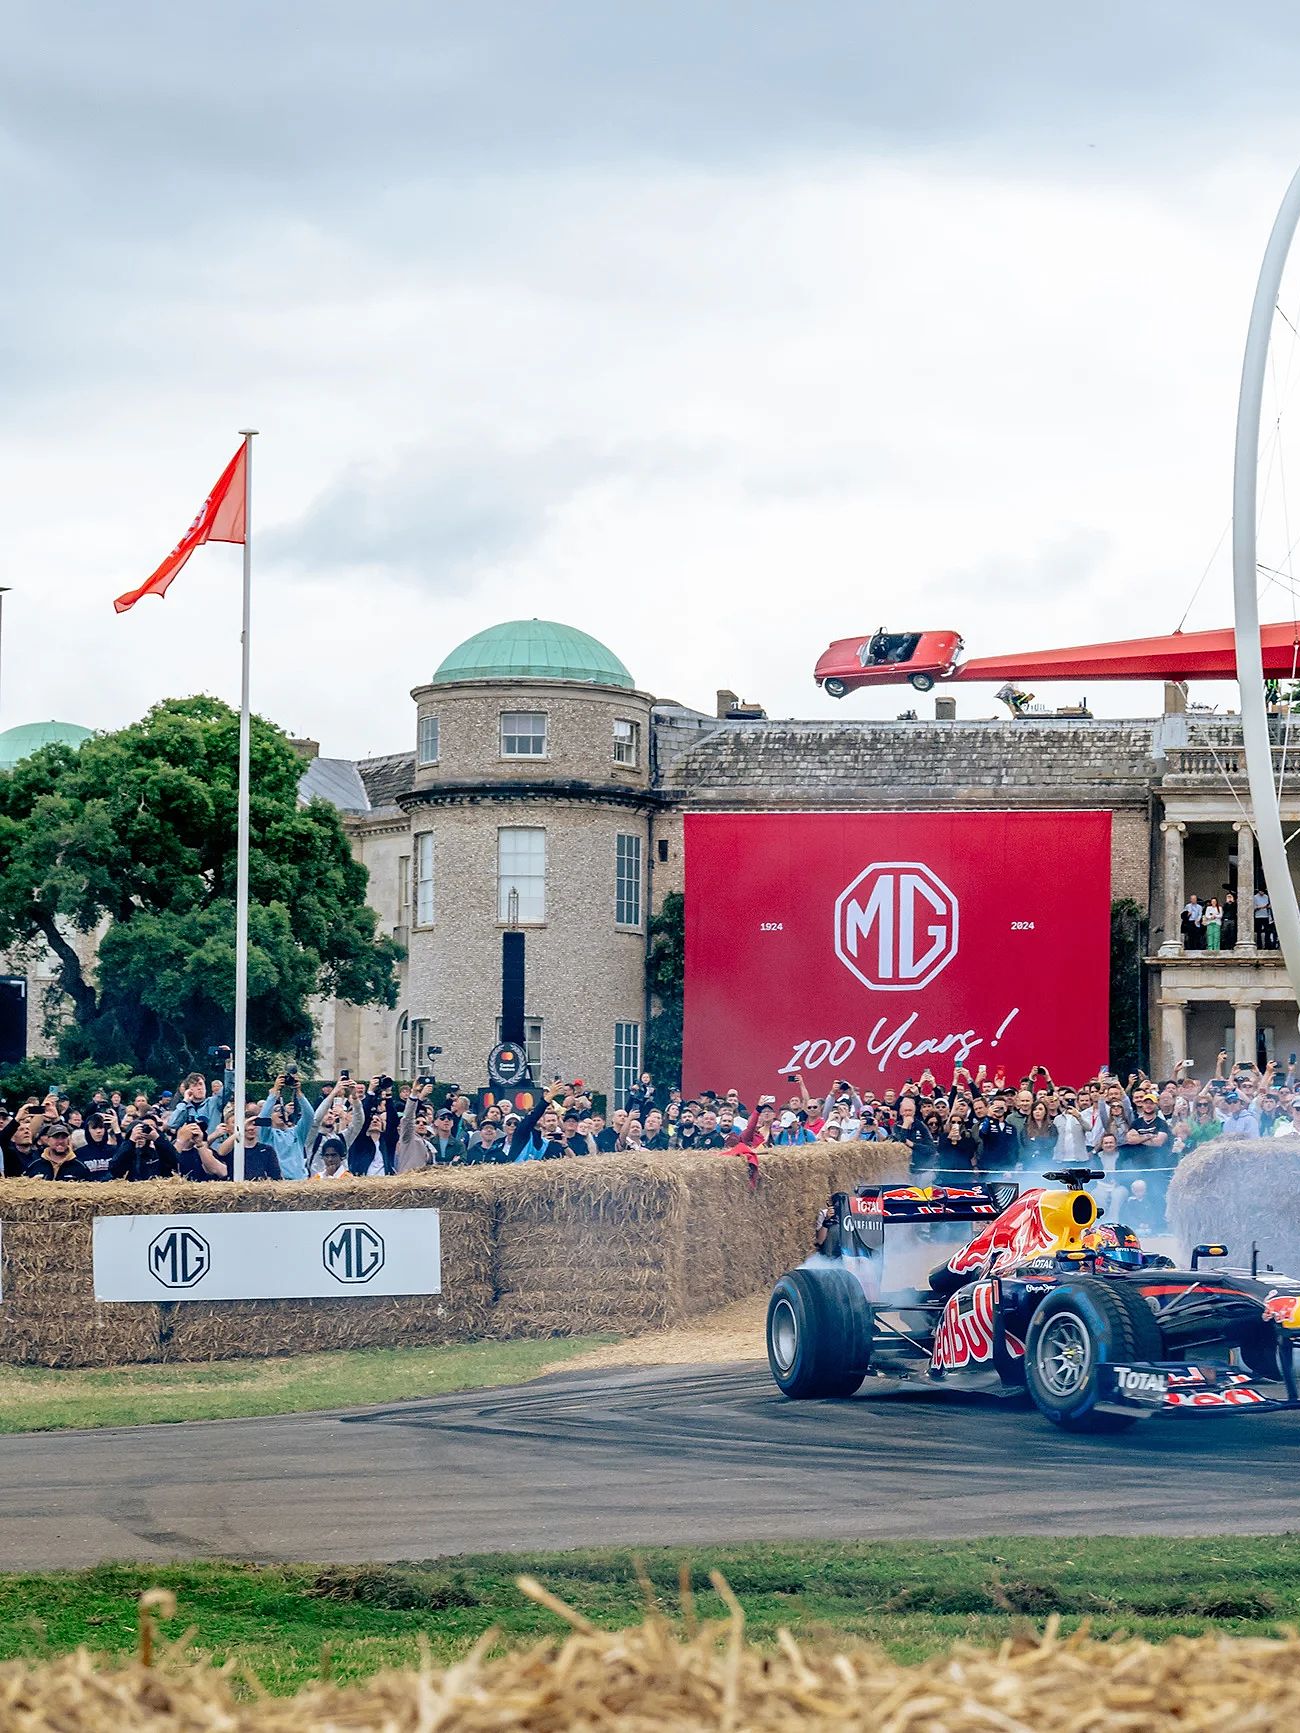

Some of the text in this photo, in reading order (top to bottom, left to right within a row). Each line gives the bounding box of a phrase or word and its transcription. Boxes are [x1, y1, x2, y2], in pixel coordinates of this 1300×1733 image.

[760, 922, 783, 932] 1924
[846, 874, 947, 979] MG
[1010, 921, 1035, 931] 2024
[777, 1035, 855, 1075] 100
[856, 1197, 882, 1213] TOTAL
[154, 1232, 204, 1283] MG
[329, 1228, 379, 1278] MG
[1113, 1366, 1168, 1392] TOTAL
